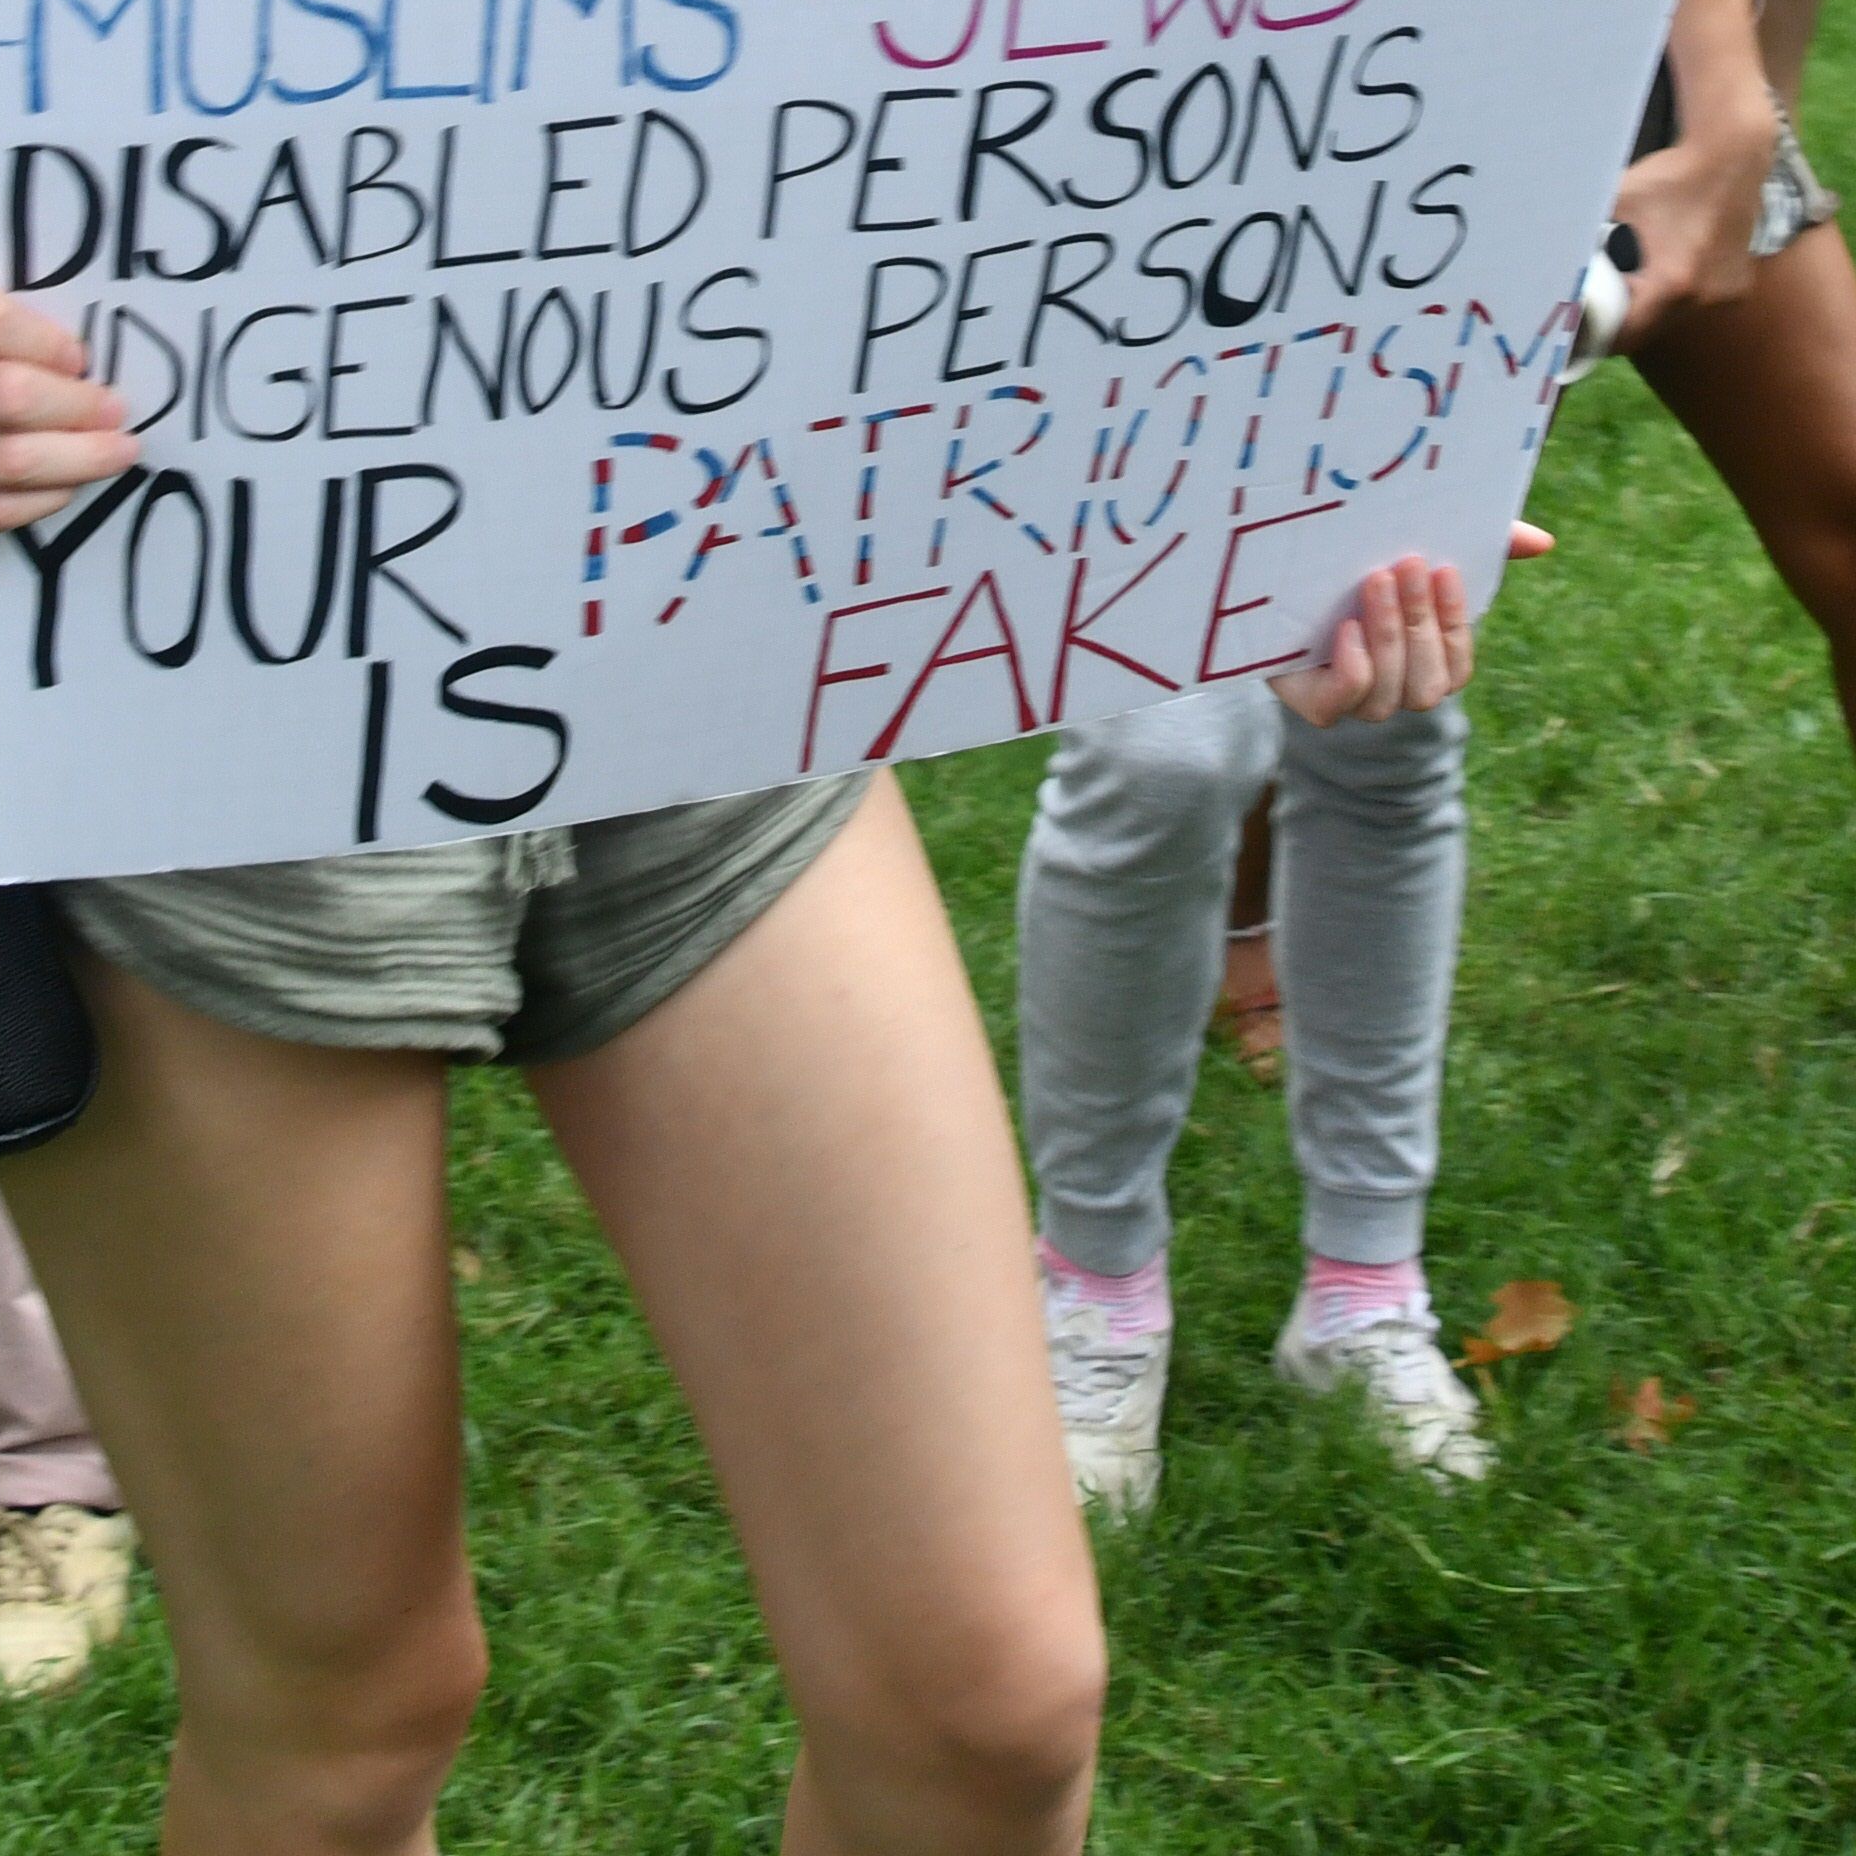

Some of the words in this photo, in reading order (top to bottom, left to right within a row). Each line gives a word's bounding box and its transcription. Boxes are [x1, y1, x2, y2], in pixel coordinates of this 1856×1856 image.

[6, 108, 712, 293] DISABLED
[763, 26, 1425, 240] PERSONS
[852, 163, 1476, 394] PERSONS
[7, 464, 471, 690] YOUR
[581, 266, 1586, 636] PATRIOTISM
[353, 645, 571, 845] IS
[799, 499, 1347, 773] FAKE
